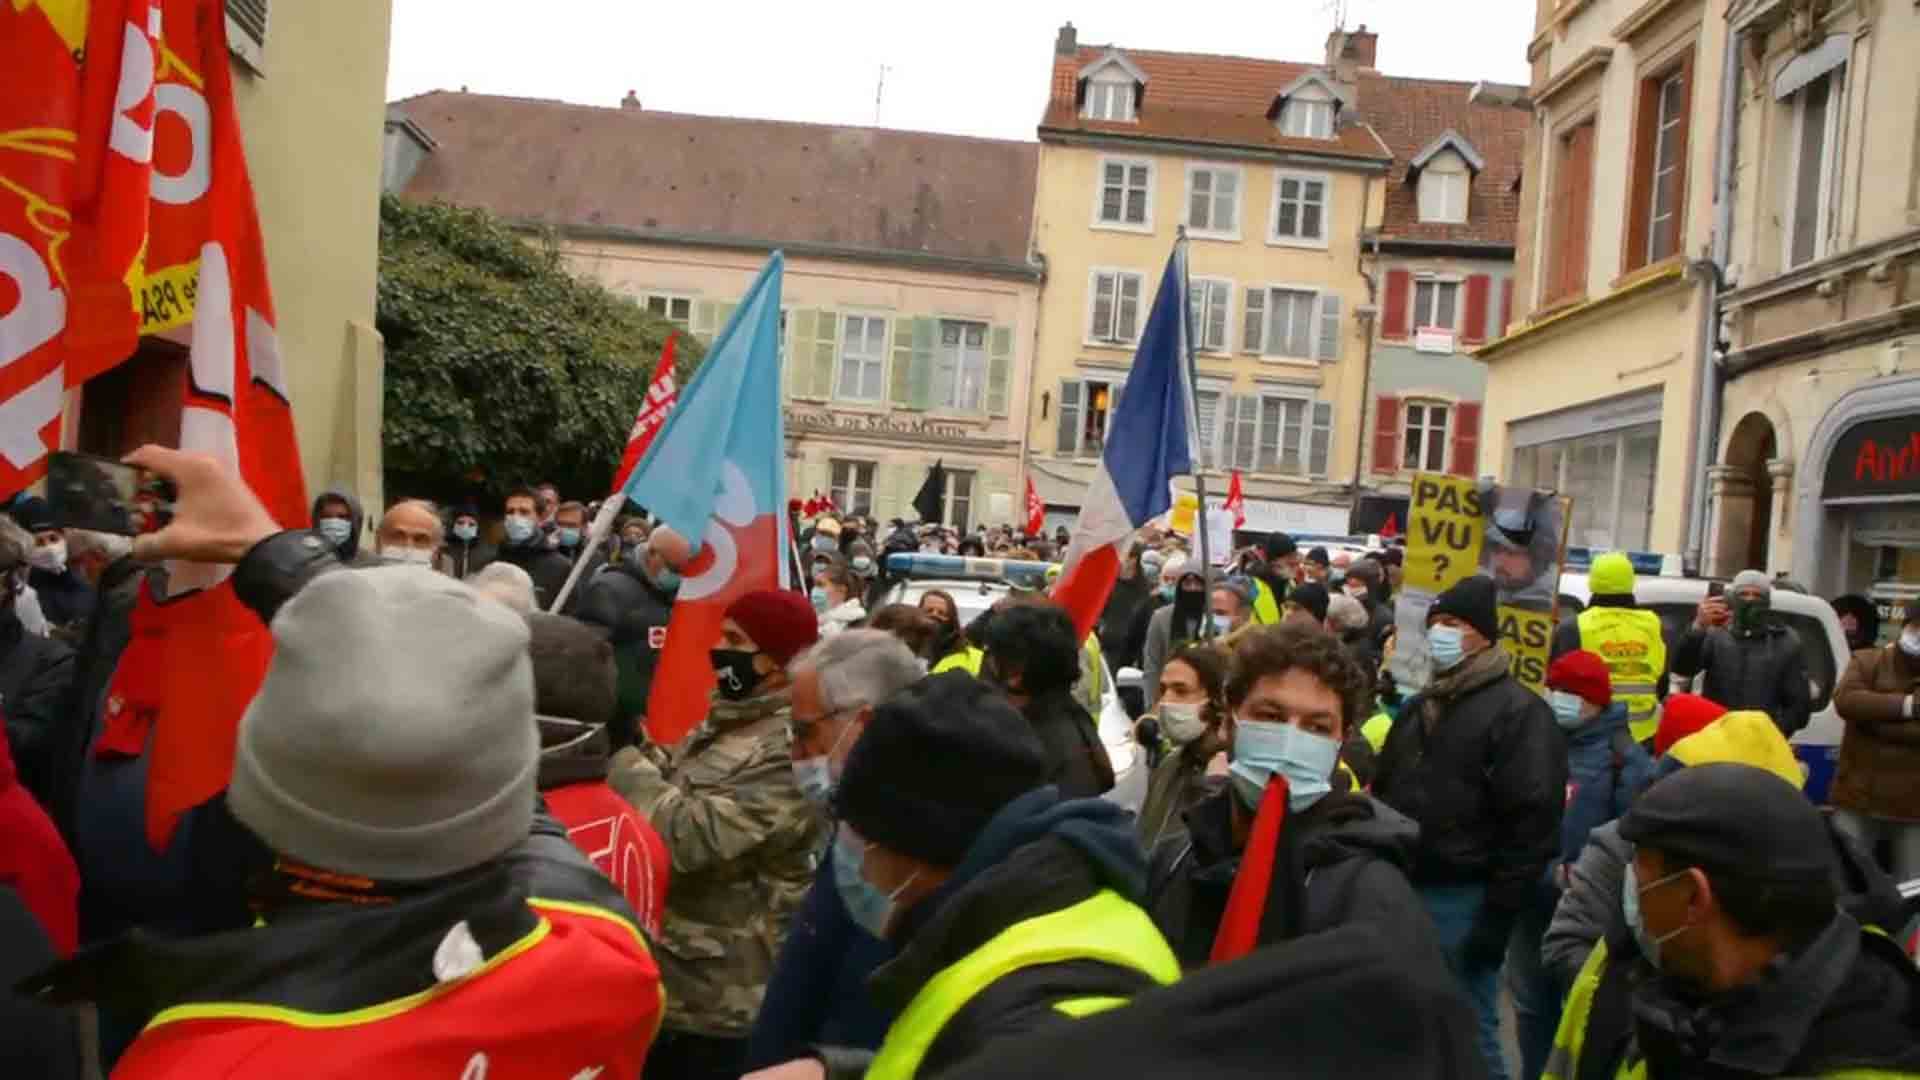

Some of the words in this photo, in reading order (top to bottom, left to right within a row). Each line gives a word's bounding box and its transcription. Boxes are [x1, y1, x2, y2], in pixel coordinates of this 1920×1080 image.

[1416, 481, 1483, 518] PAS
[1421, 517, 1472, 550] VU
[1432, 554, 1449, 582] ?
[1500, 615, 1547, 648] AS
